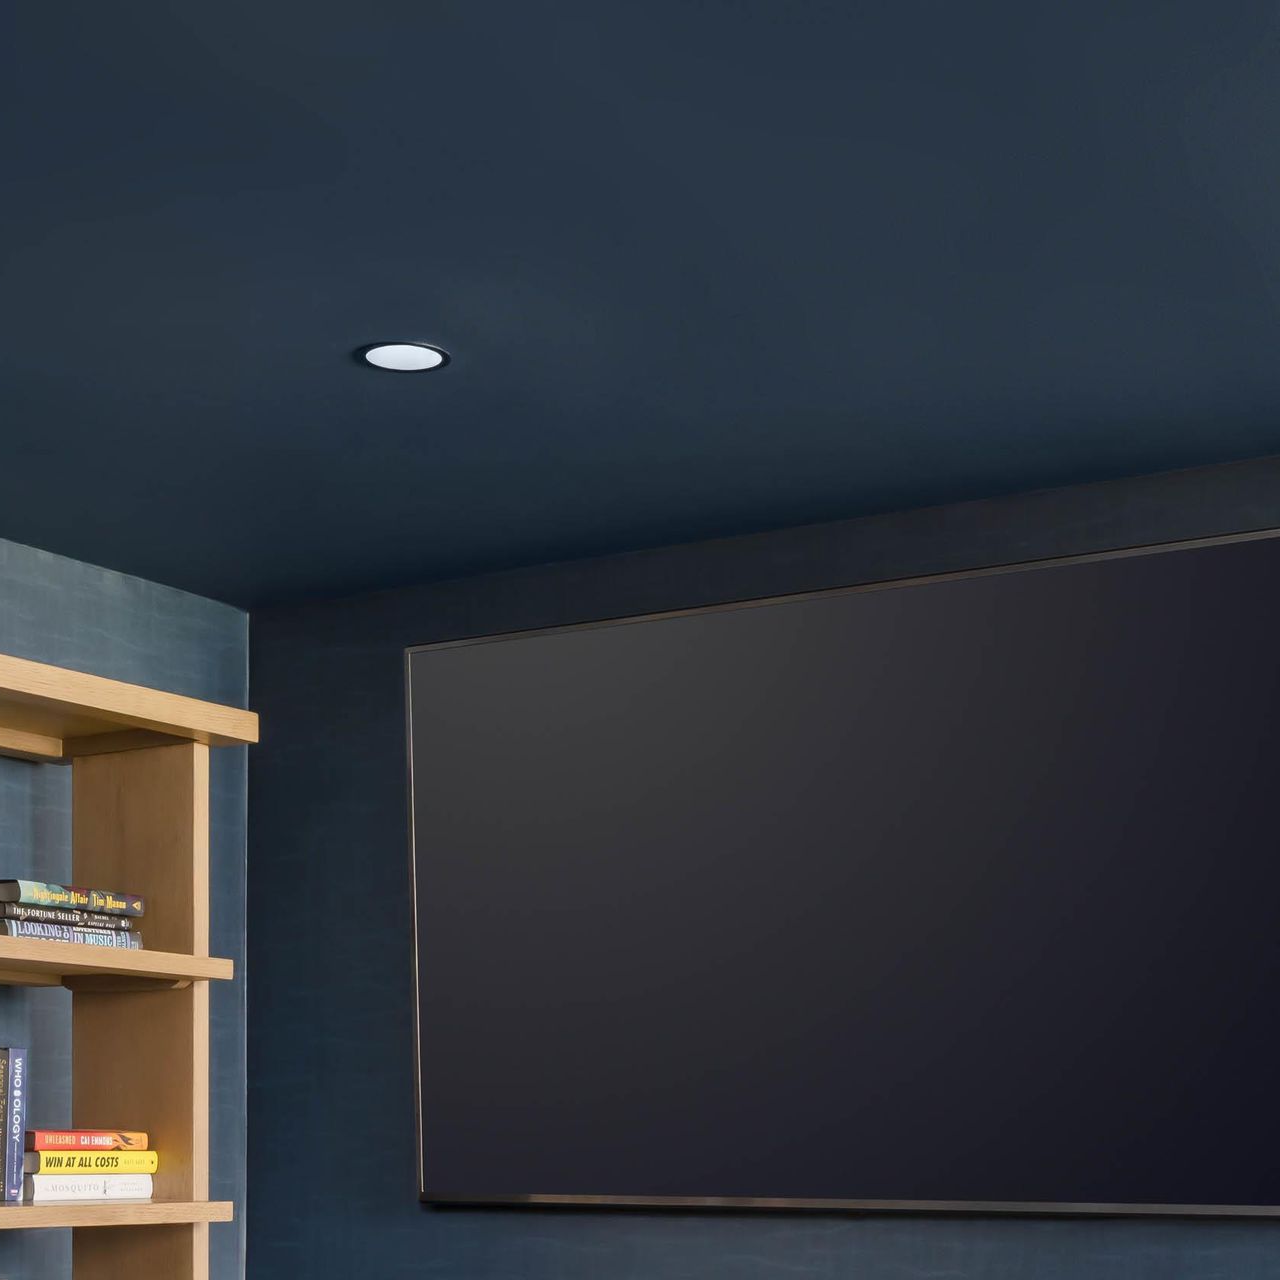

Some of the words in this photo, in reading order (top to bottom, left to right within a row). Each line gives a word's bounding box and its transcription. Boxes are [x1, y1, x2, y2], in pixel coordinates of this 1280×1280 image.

[33, 888, 68, 904] Nightingale
[71, 892, 88, 904] Affair
[92, 894, 104, 906] Tim
[106, 895, 126, 908] Mason
[27, 908, 55, 919] FORTUNE
[58, 911, 80, 922] SELLER
[17, 922, 60, 937] LOOKING
[74, 932, 83, 944] IN
[86, 933, 113, 947] MUSIC
[14, 1058, 22, 1088] WHO
[13, 1099, 22, 1142] OLOGY
[45, 1135, 76, 1145] UNLEASHED
[45, 1156, 64, 1167] WIN
[66, 1157, 76, 1167] AT
[78, 1157, 91, 1167] ALL
[95, 1157, 119, 1167] COSTS
[51, 1185, 98, 1193] MOSQUITO
